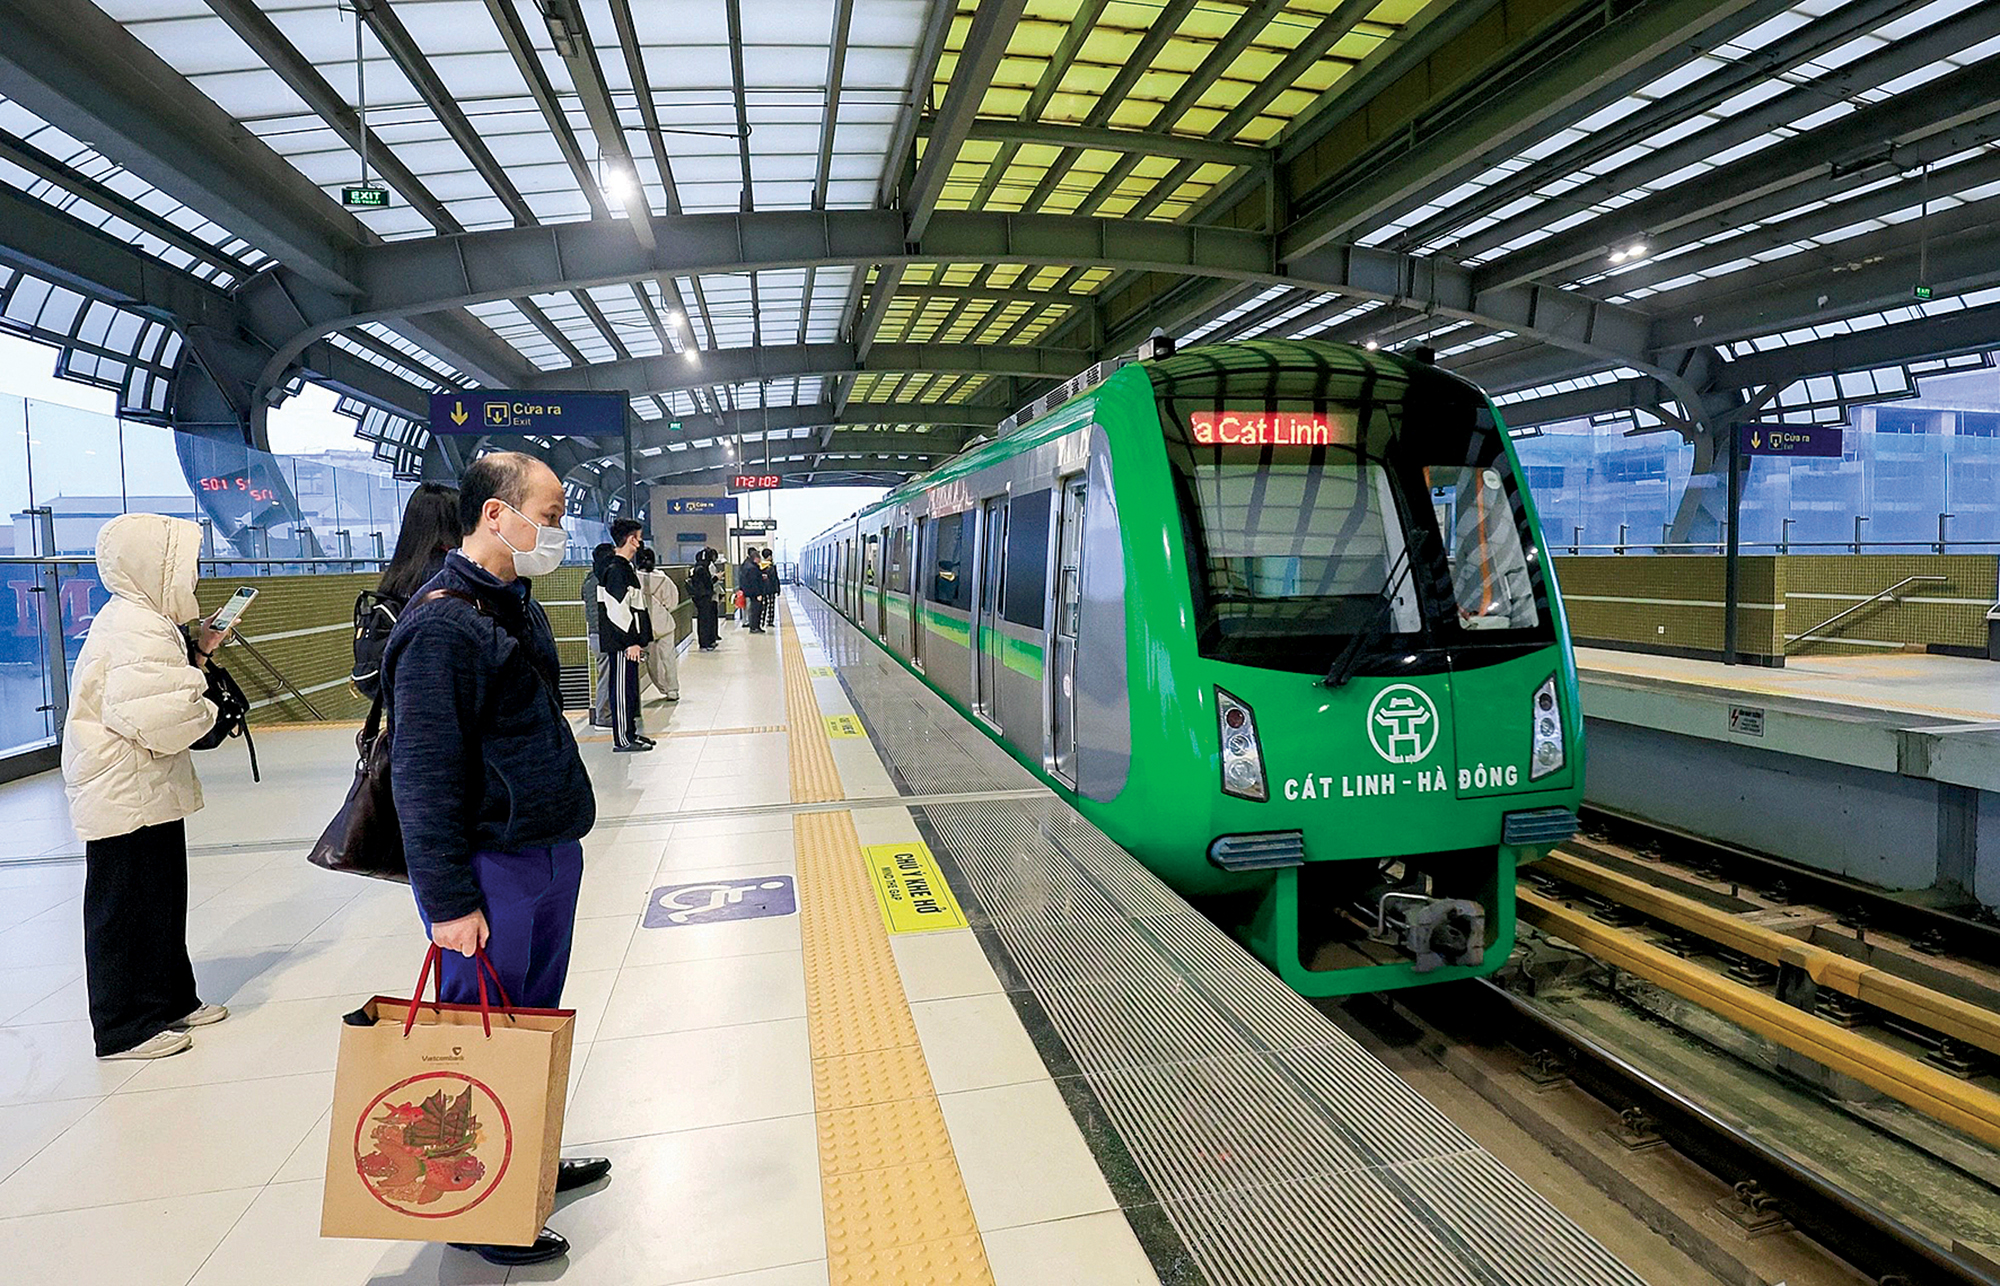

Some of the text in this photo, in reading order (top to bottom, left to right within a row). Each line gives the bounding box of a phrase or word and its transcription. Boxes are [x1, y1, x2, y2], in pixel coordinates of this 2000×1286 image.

[351, 191, 381, 200] EXIT
[513, 402, 562, 415] Cửa ra
[513, 417, 531, 426] Exit
[1219, 417, 1268, 444] Cát
[1274, 418, 1328, 445] Linh
[1284, 773, 1332, 800] CÁT
[1342, 773, 1395, 797] LINH
[1418, 765, 1447, 792] HÀ
[1458, 763, 1518, 790] ĐÔNG
[894, 853, 923, 870] CHÚ
[889, 889, 903, 900] GAP
[904, 878, 932, 897] KHE
[913, 899, 947, 914] HỞ
